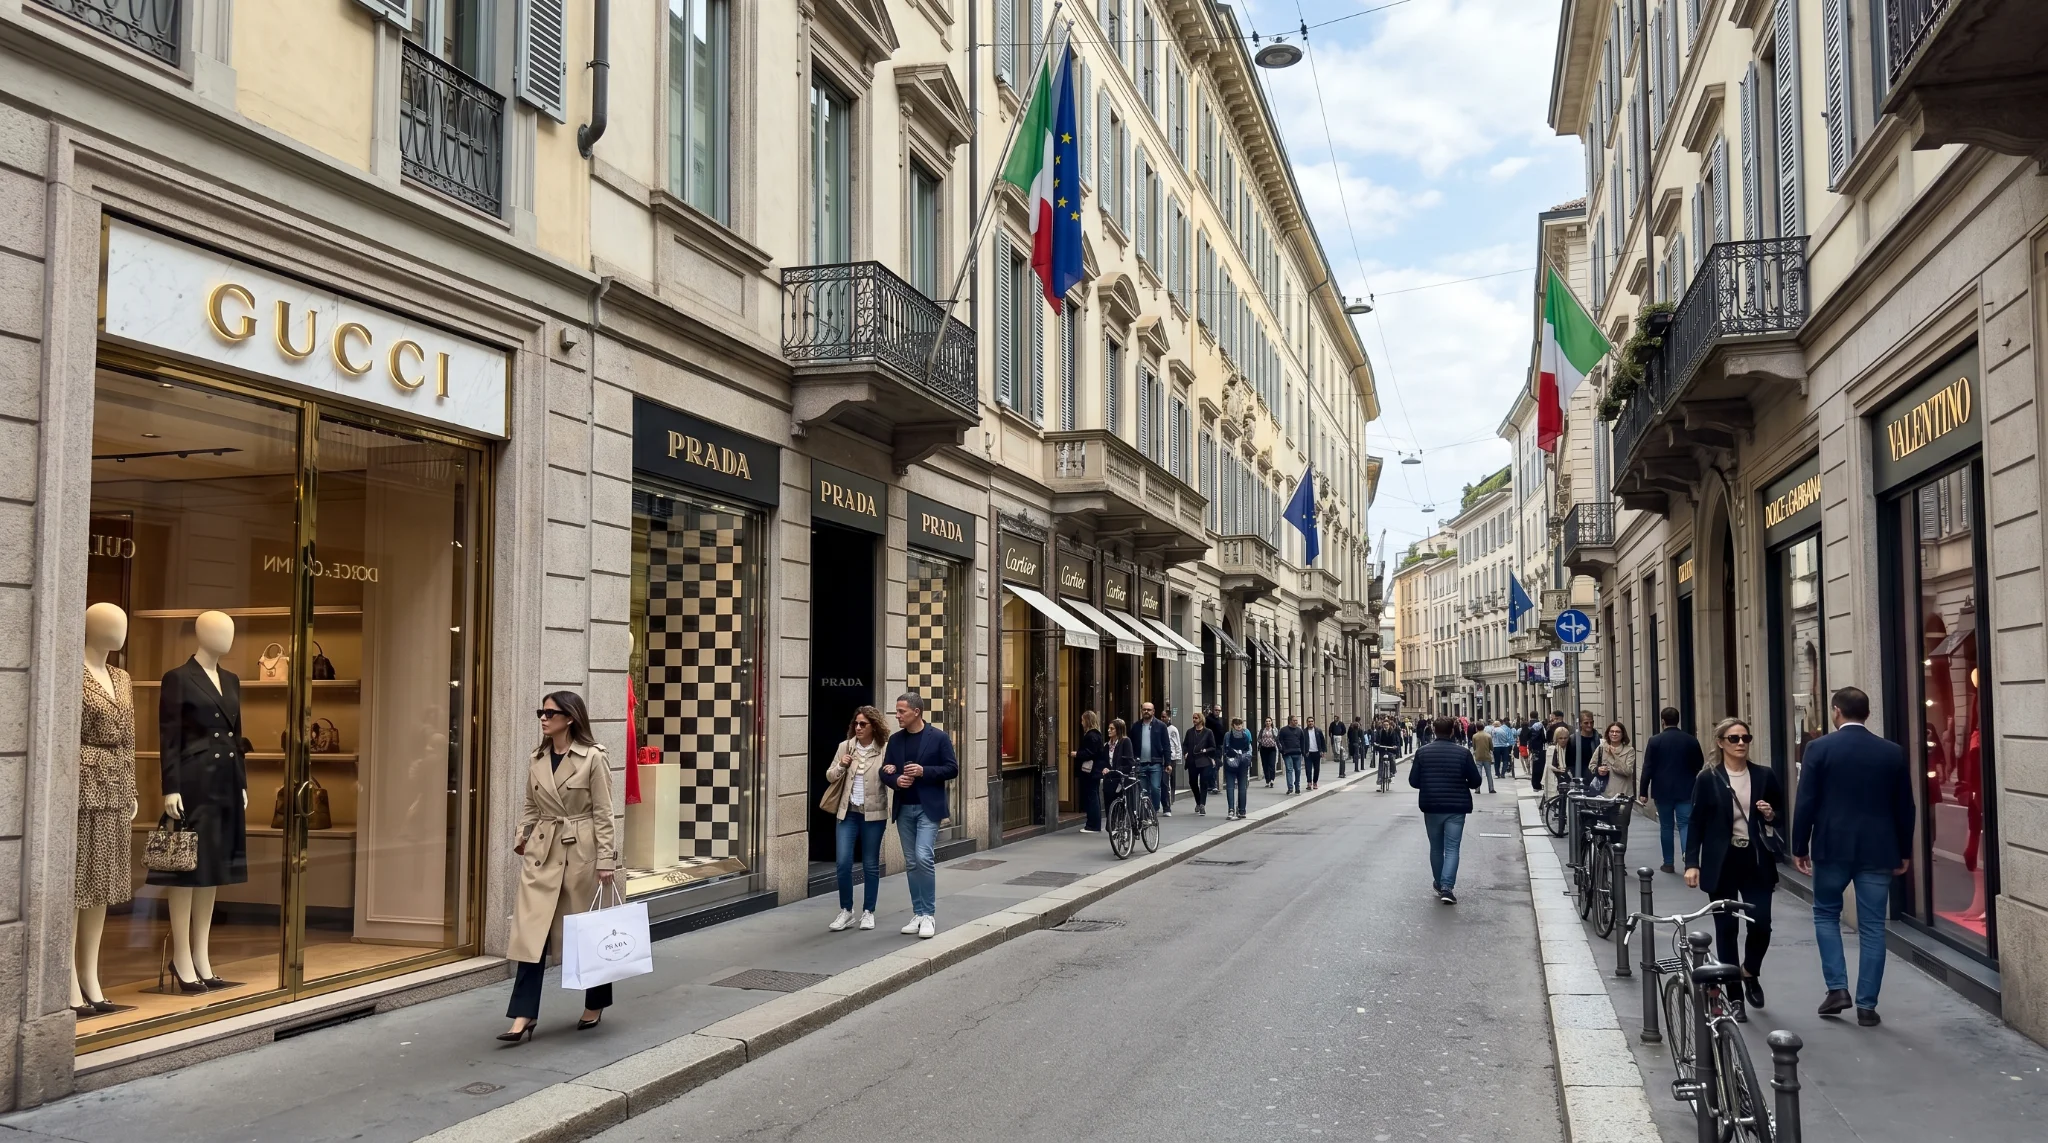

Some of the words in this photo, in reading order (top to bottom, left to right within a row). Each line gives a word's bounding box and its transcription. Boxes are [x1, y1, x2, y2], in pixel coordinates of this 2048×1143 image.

[207, 284, 450, 399] GUCCI
[1887, 377, 1971, 462] VALENTINO
[667, 430, 752, 481] PRADA
[820, 480, 878, 518] PRADA
[1765, 494, 1786, 529] DOLCE
[921, 513, 964, 542] PRADA
[1005, 547, 1037, 576] Cartier
[1061, 565, 1086, 591] Cartier
[1106, 579, 1127, 602] Cartier
[821, 677, 864, 687] PRADA
